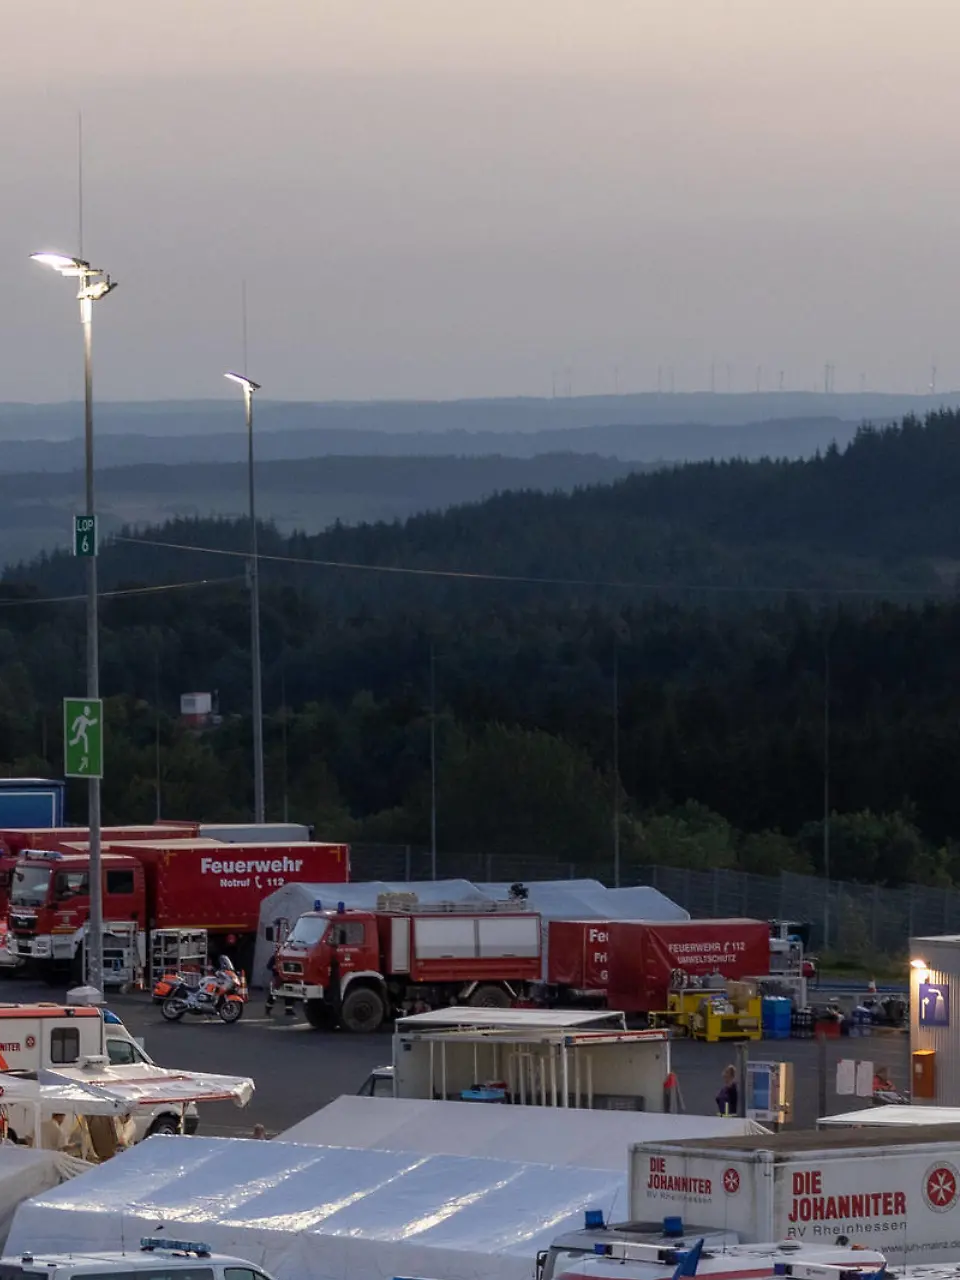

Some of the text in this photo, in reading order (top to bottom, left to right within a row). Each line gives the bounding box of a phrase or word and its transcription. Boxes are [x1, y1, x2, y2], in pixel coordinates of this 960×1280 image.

[200, 856, 303, 875] Feuerwehr
[220, 877, 285, 888] Notruf 112
[668, 941, 746, 953] FEUERWEHR 112
[677, 954, 737, 964] UMWELTSCHUTZ
[649, 1156, 666, 1173] DIE
[647, 1174, 712, 1194] JOHANNITER
[792, 1171, 822, 1195] DIE
[788, 1192, 906, 1222] JOHANNITER
[788, 1221, 907, 1238] RV Rheinhessen
